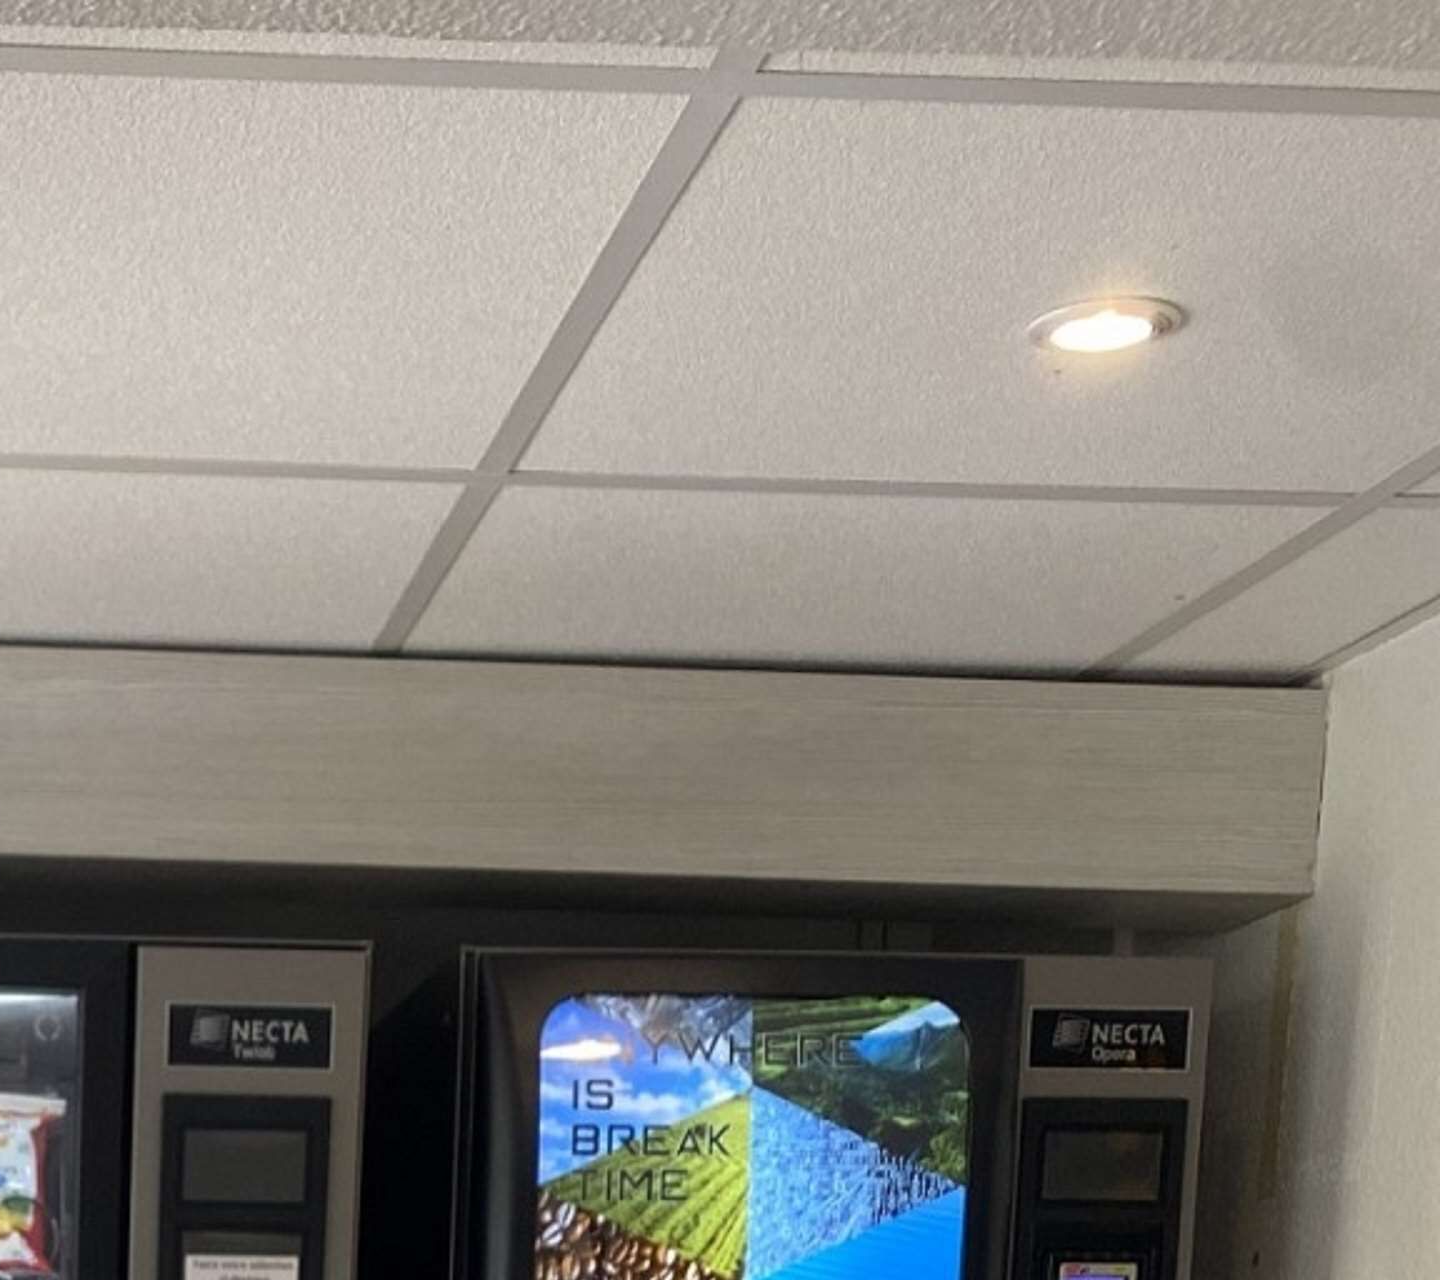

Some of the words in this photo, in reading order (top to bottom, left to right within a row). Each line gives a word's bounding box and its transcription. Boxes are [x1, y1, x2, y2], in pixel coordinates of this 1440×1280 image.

[231, 1020, 310, 1044] NECTA
[1092, 1024, 1165, 1045] NECTA
[620, 1032, 863, 1068] YWHERE
[573, 1080, 614, 1110] IS
[572, 1124, 730, 1156] BREAK
[571, 1170, 689, 1201] TIME
